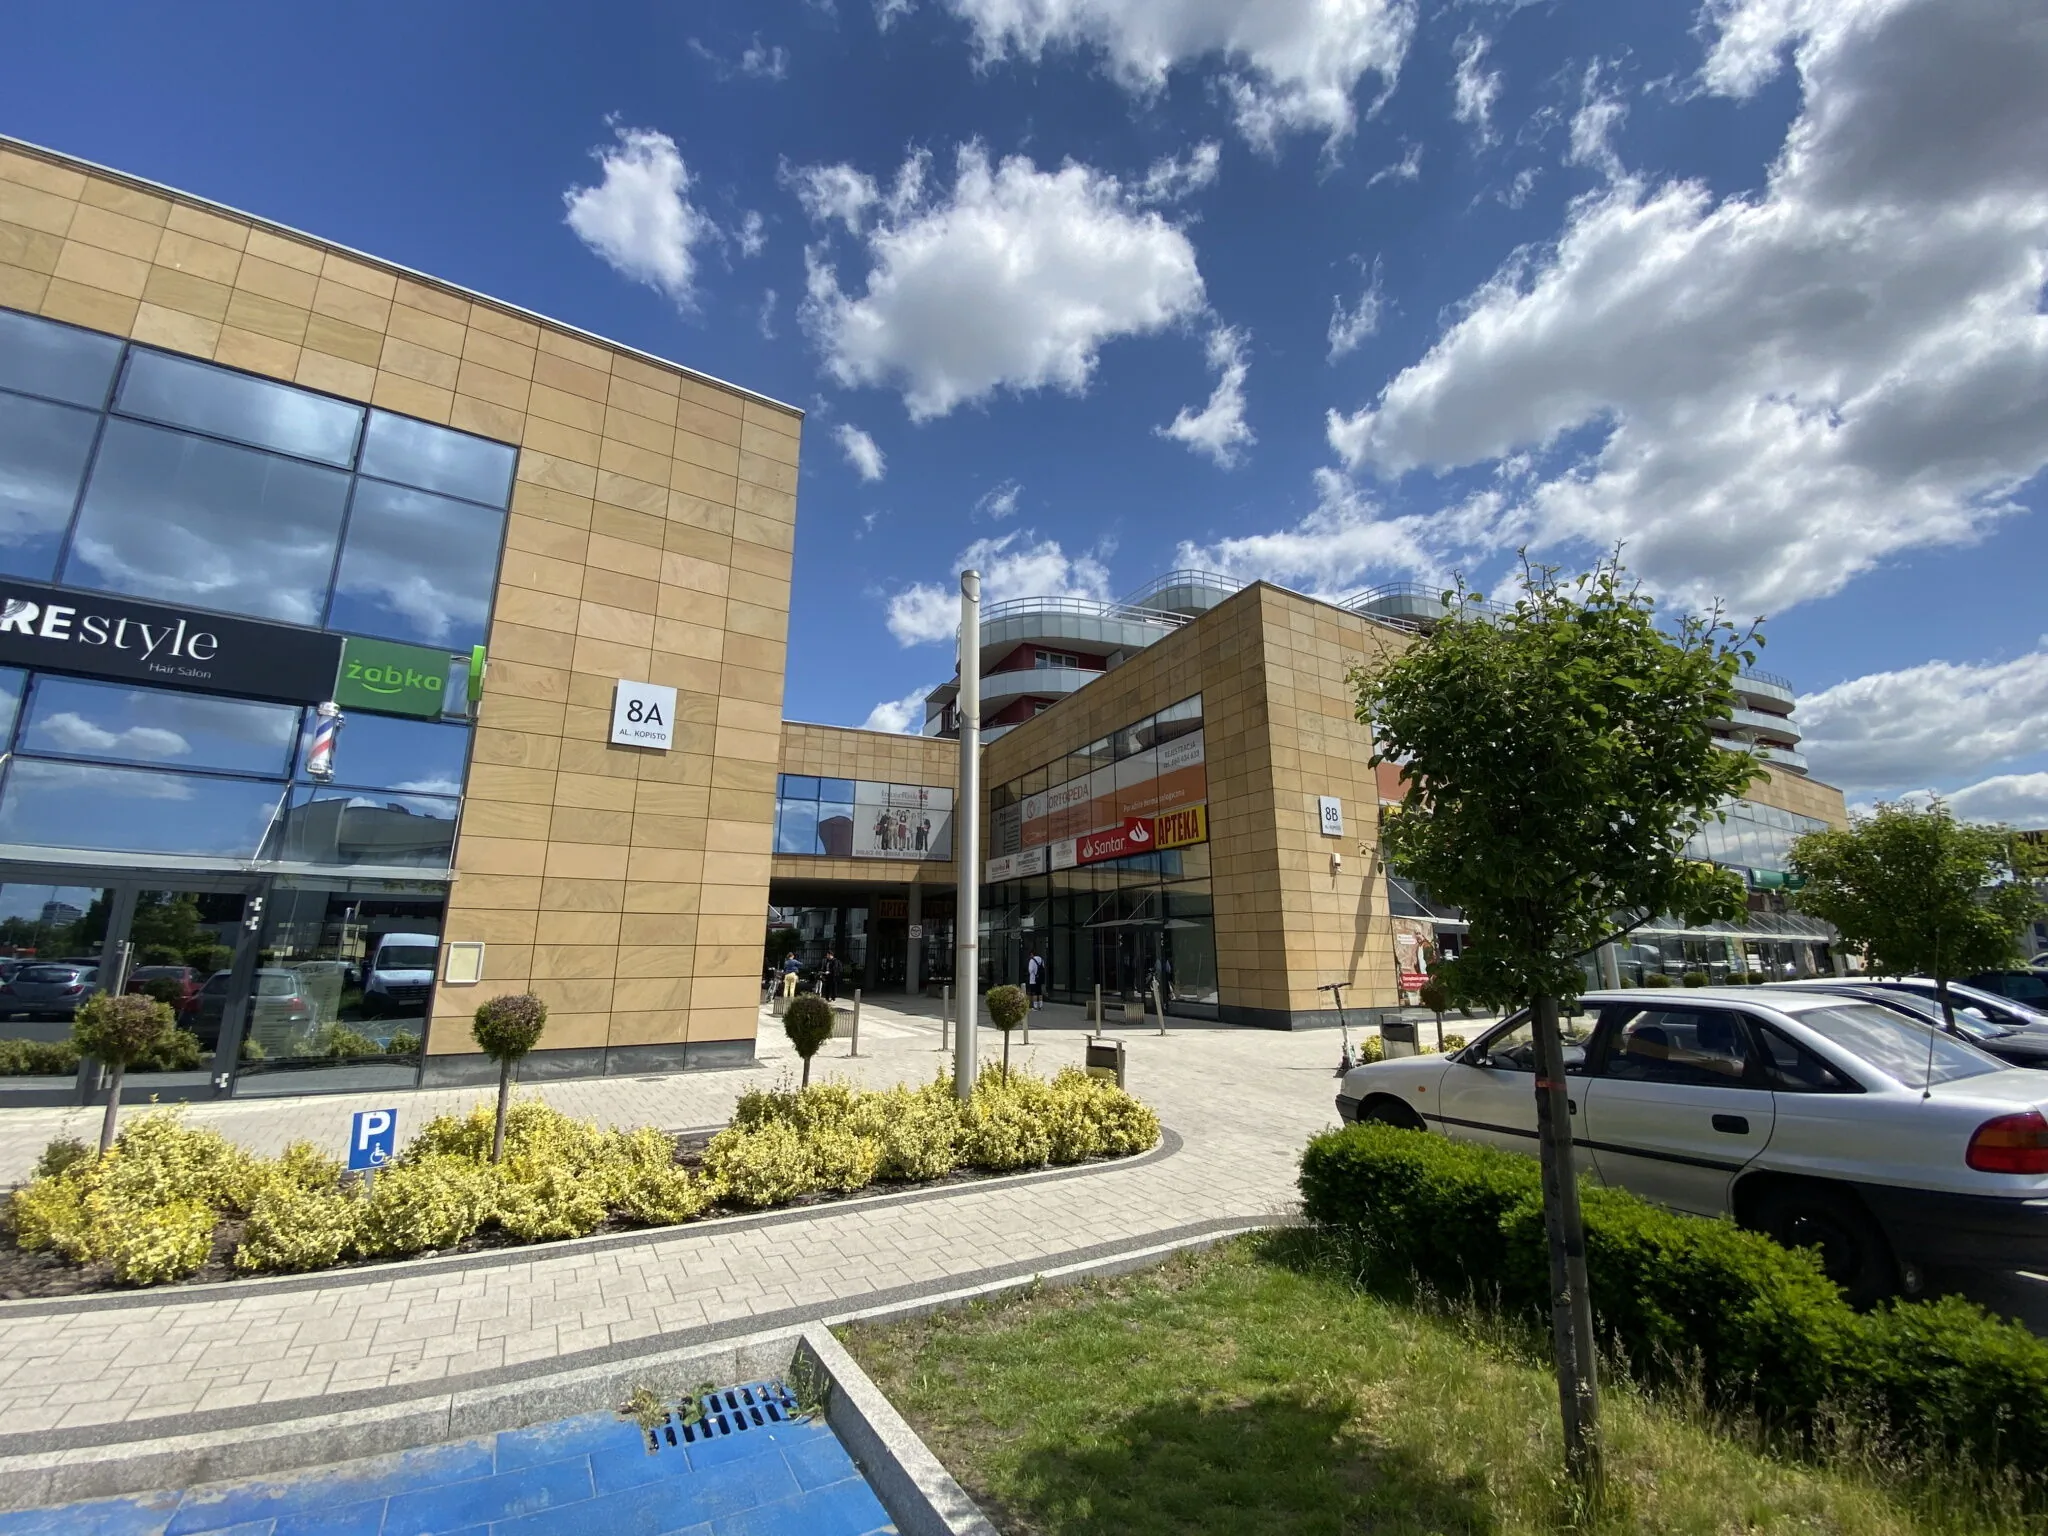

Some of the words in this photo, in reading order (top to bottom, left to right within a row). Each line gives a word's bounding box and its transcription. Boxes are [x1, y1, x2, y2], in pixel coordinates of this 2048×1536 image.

[149, 662, 174, 674] Hair
[177, 666, 212, 679] Salon
[346, 659, 442, 691] żabka
[627, 699, 663, 726] 8A
[619, 728, 632, 737] AL.
[634, 730, 667, 741] KOPISTO
[1158, 809, 1200, 845] APTEKA
[1325, 806, 1339, 822] 8B
[359, 1111, 391, 1151] P
